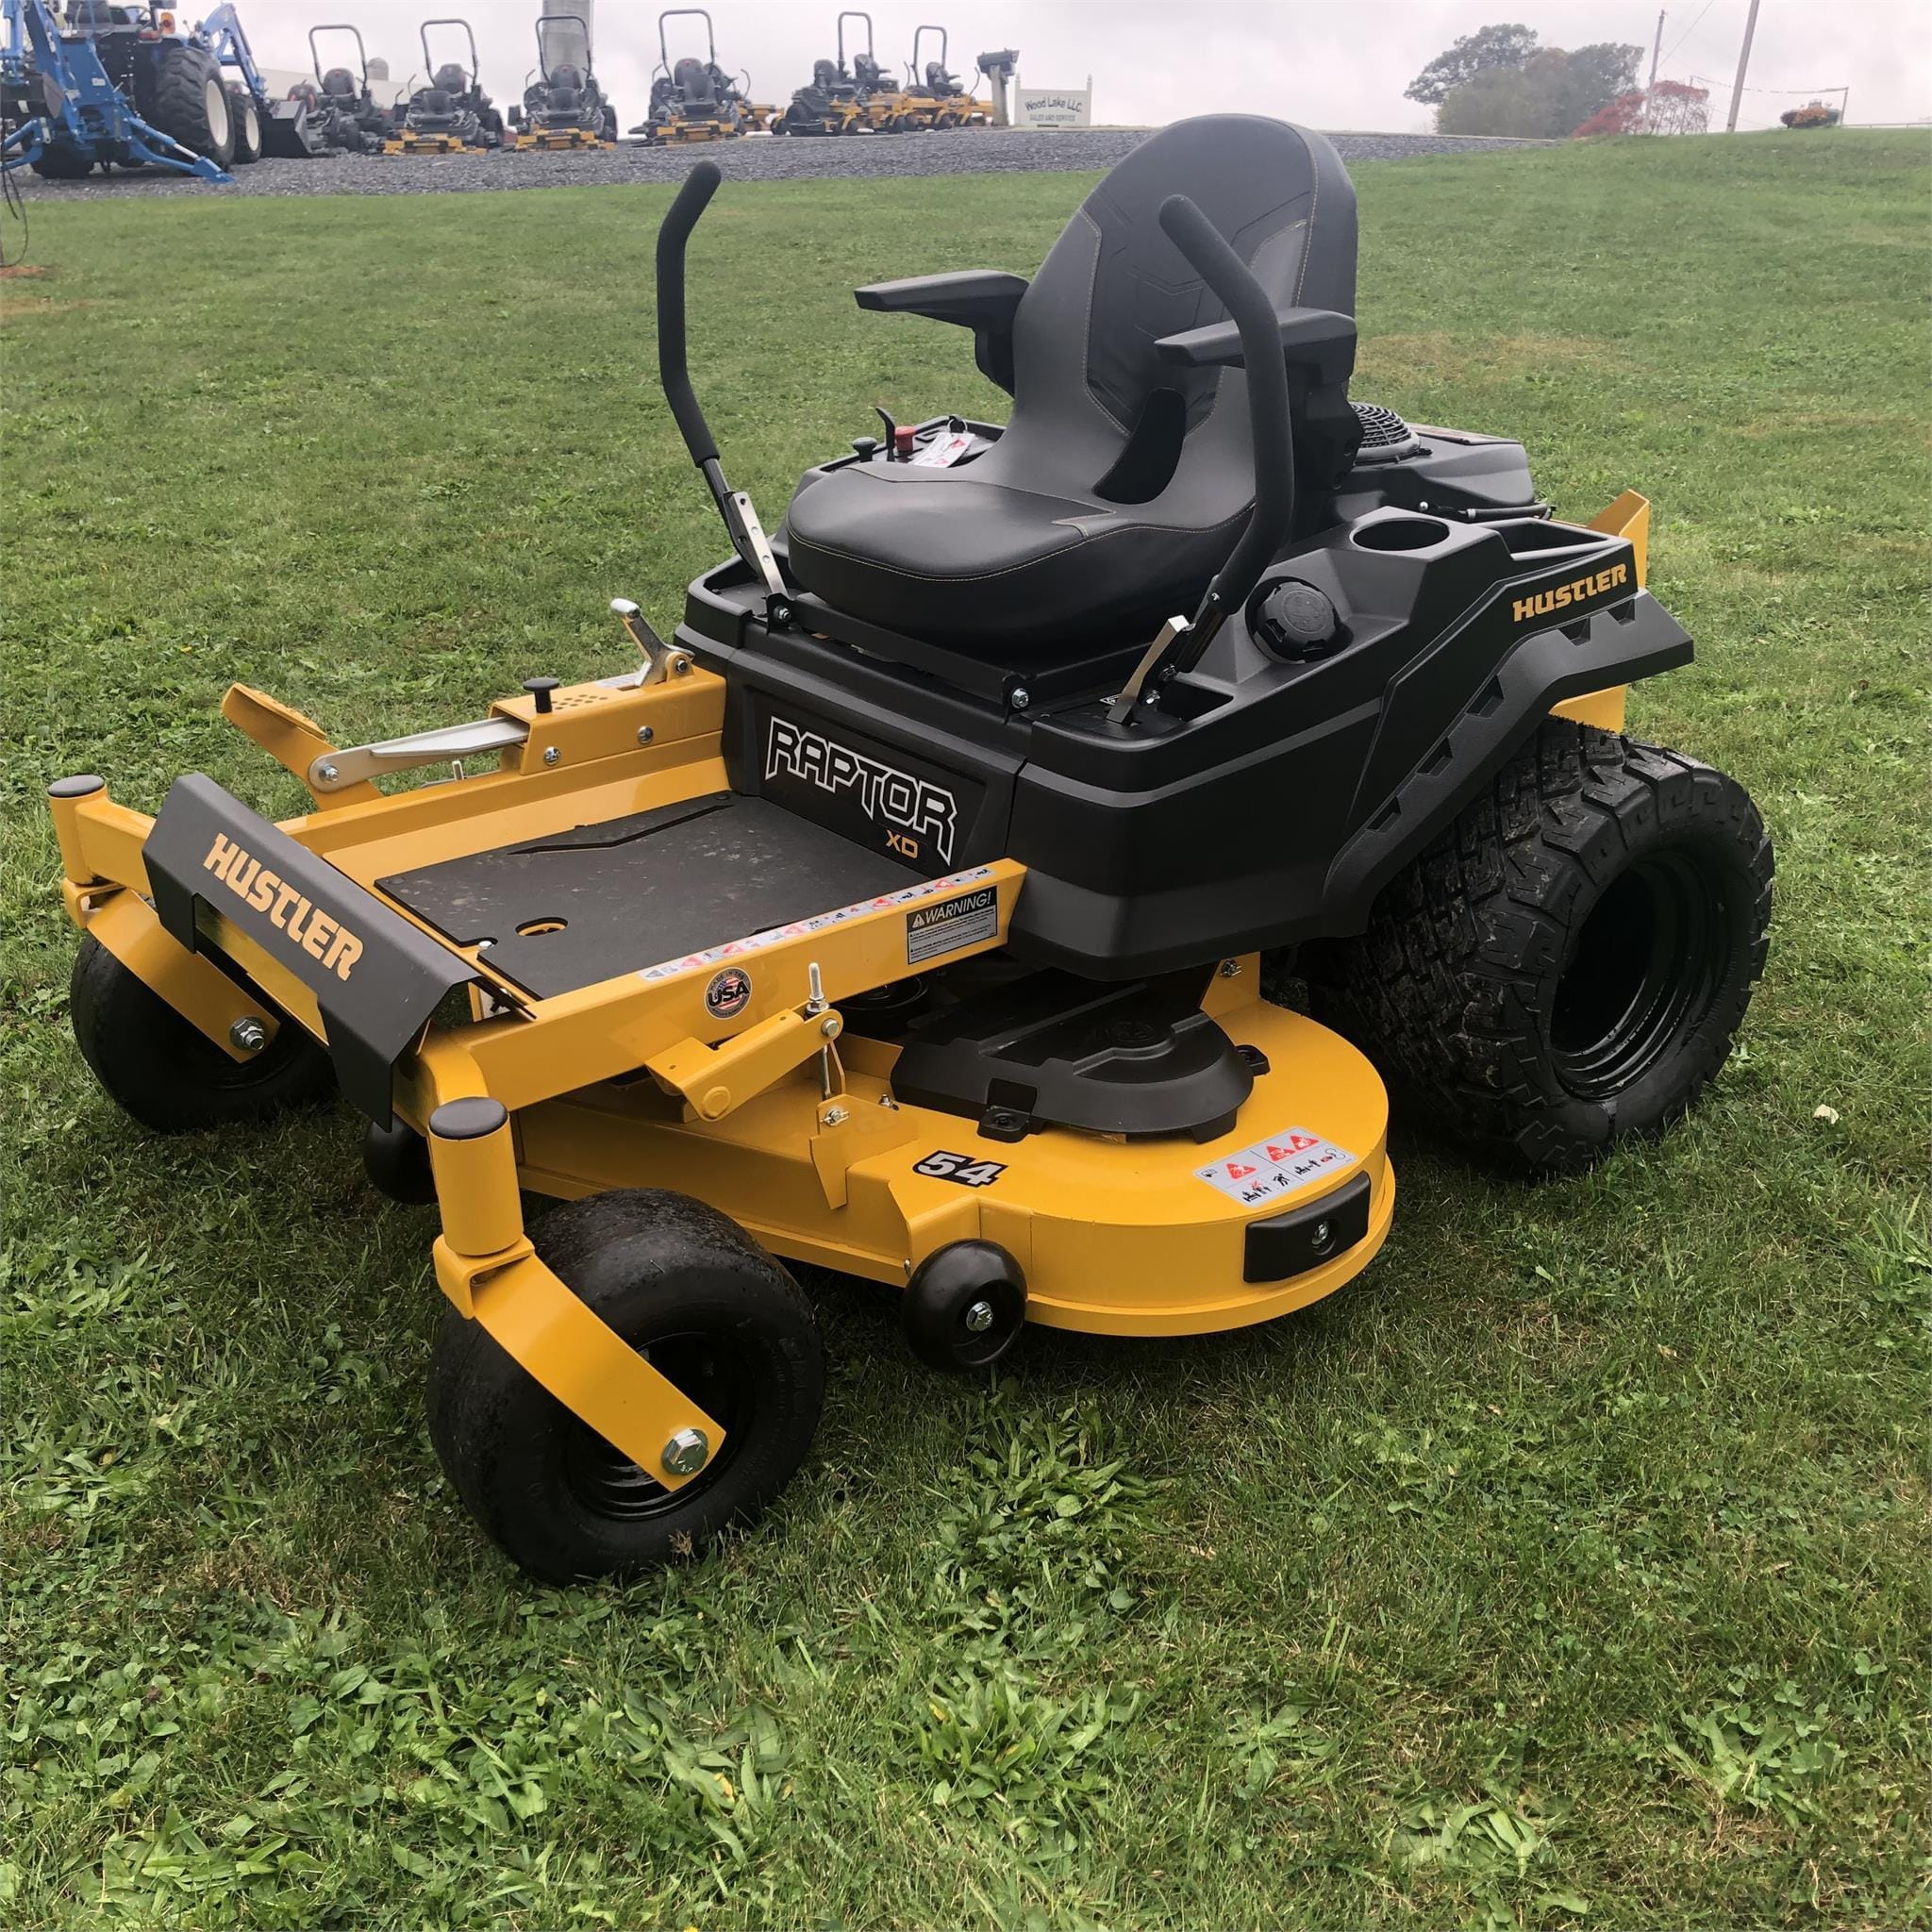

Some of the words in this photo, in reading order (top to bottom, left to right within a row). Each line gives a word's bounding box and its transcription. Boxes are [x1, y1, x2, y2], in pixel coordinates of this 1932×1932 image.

[1025, 96, 1046, 111] Wood
[1048, 96, 1066, 108] Lake
[1512, 563, 1627, 622] HUSTLER
[765, 715, 958, 866] RAPTOR
[886, 830, 919, 859] XD
[203, 832, 364, 981] HUSTLER
[925, 891, 991, 924] WARNING!
[708, 981, 750, 1007] USA
[915, 1151, 1007, 1187] 54
